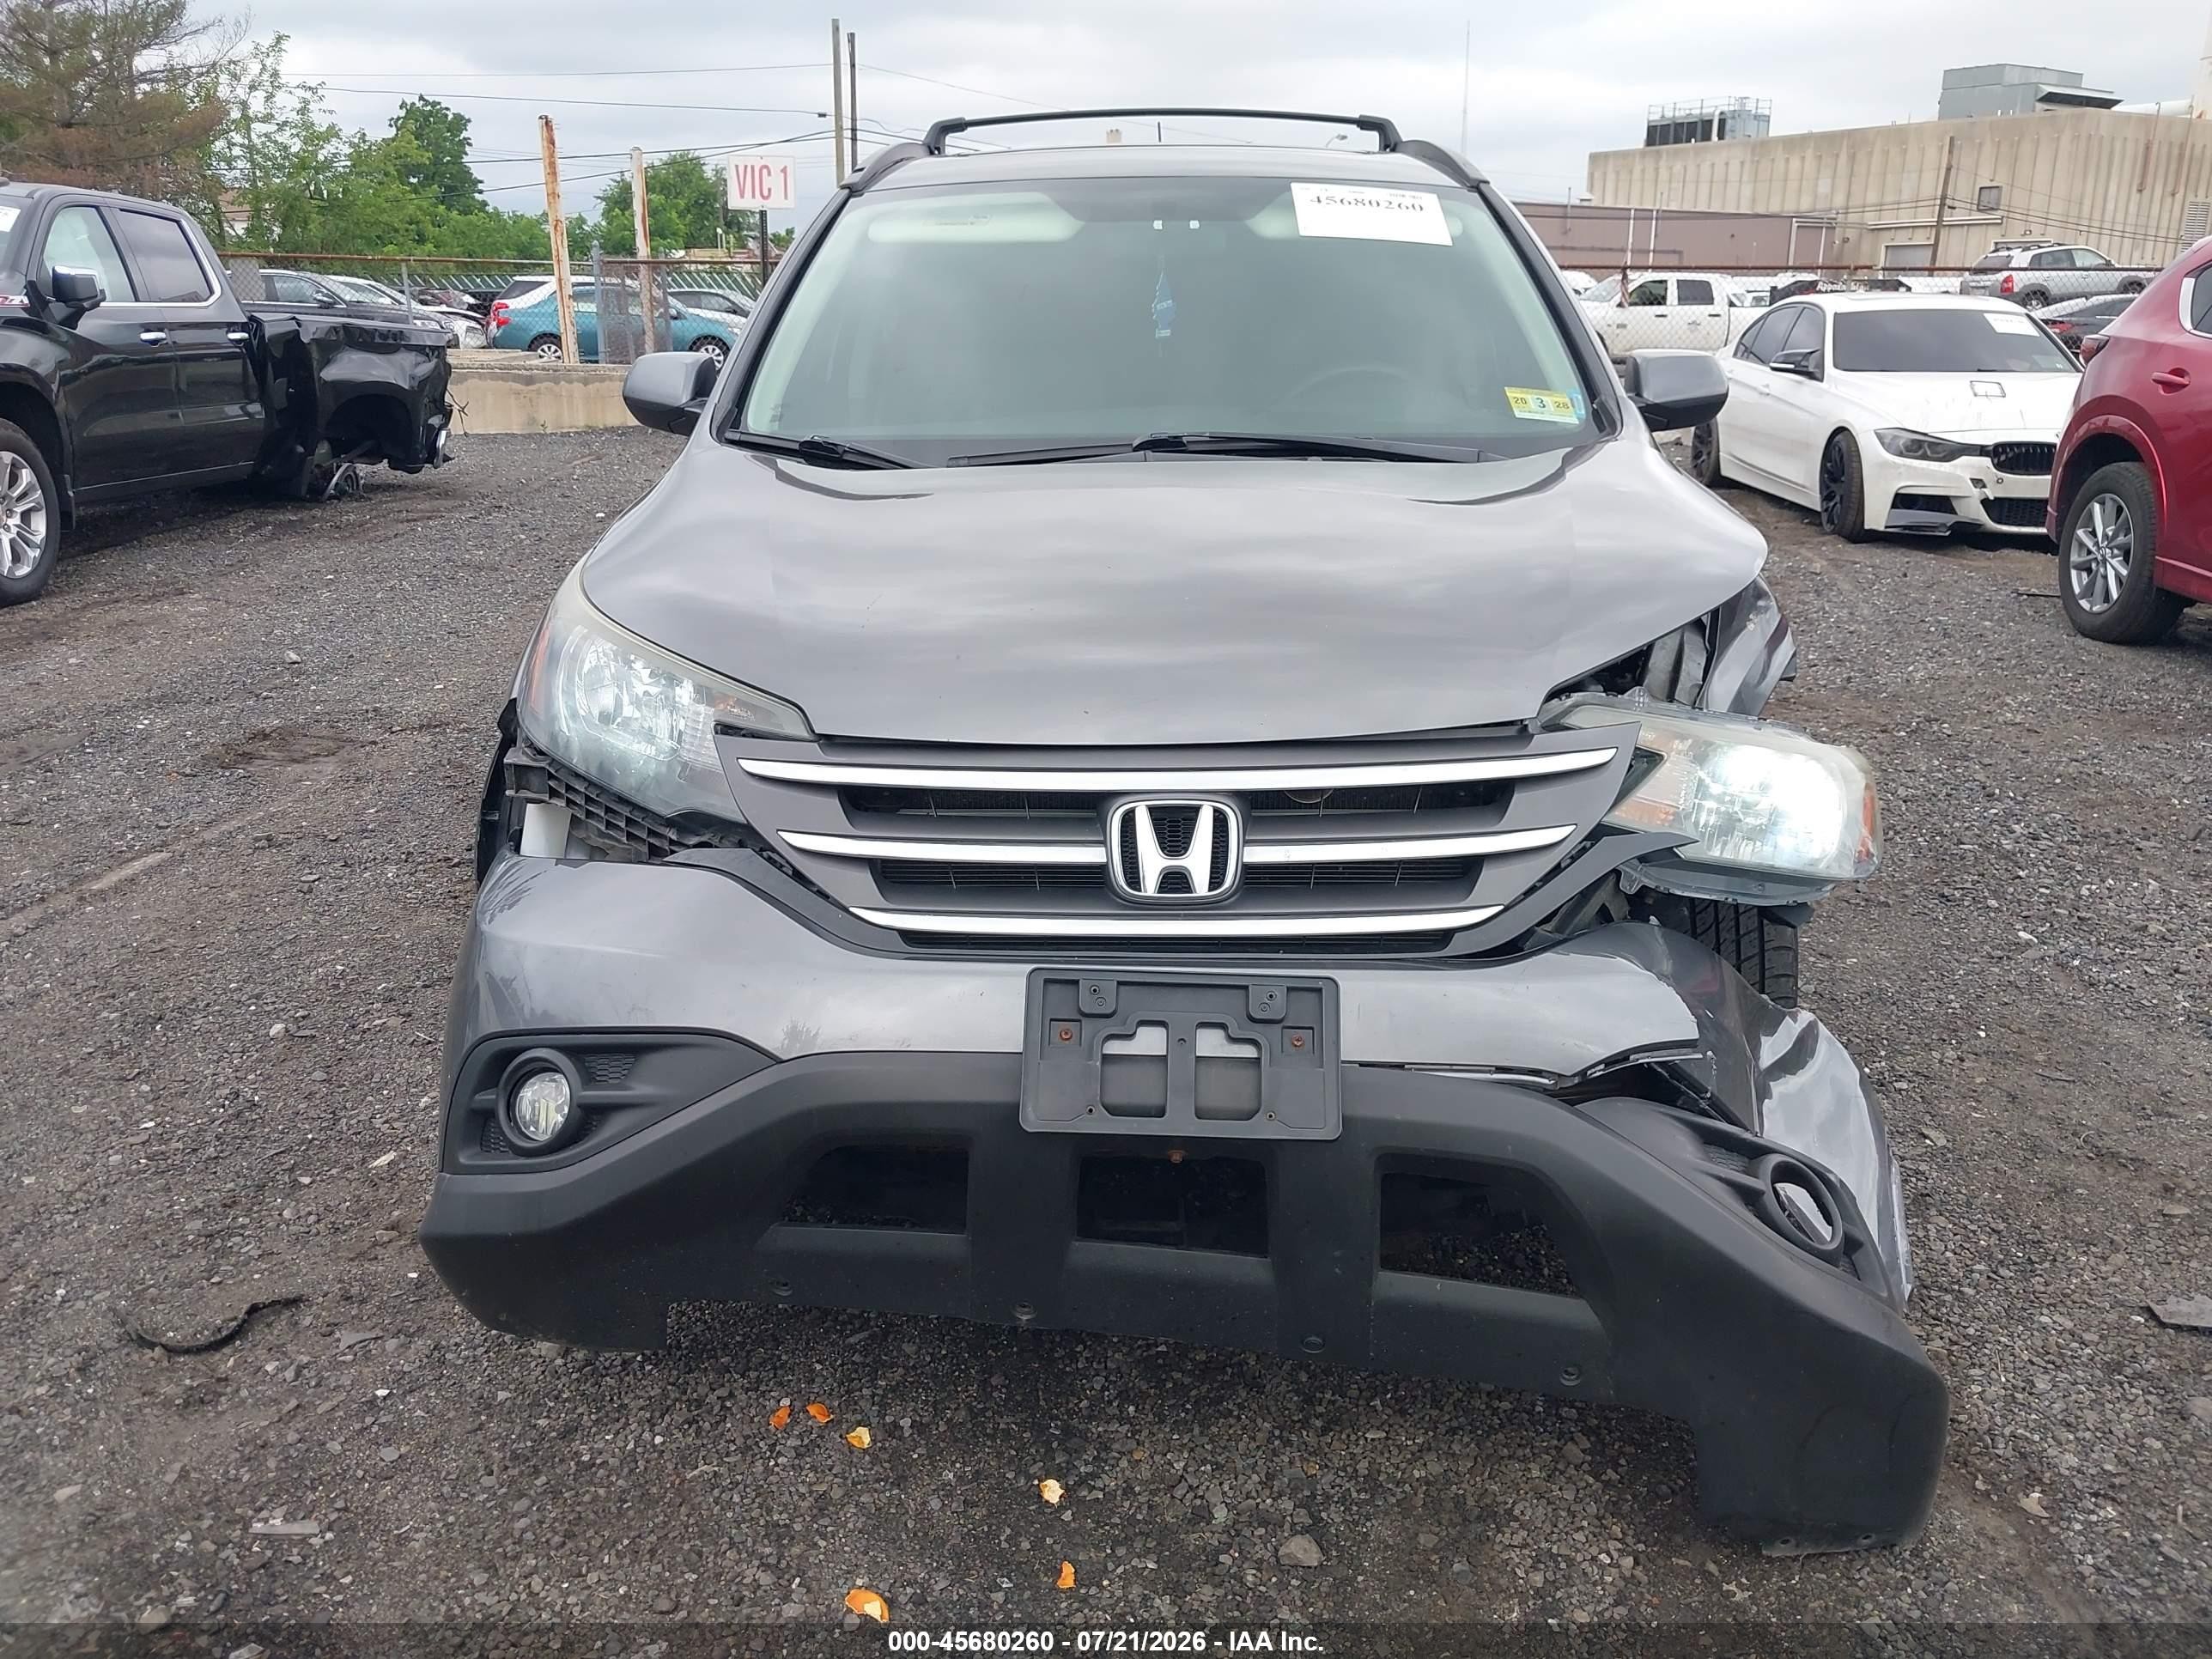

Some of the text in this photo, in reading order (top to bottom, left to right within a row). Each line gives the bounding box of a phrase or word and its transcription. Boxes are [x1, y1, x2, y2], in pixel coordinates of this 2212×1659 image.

[734, 164, 788, 200] VIC 1
[1310, 195, 1424, 212] 45680260
[1513, 397, 1527, 405] 20
[1536, 397, 1547, 409] 3
